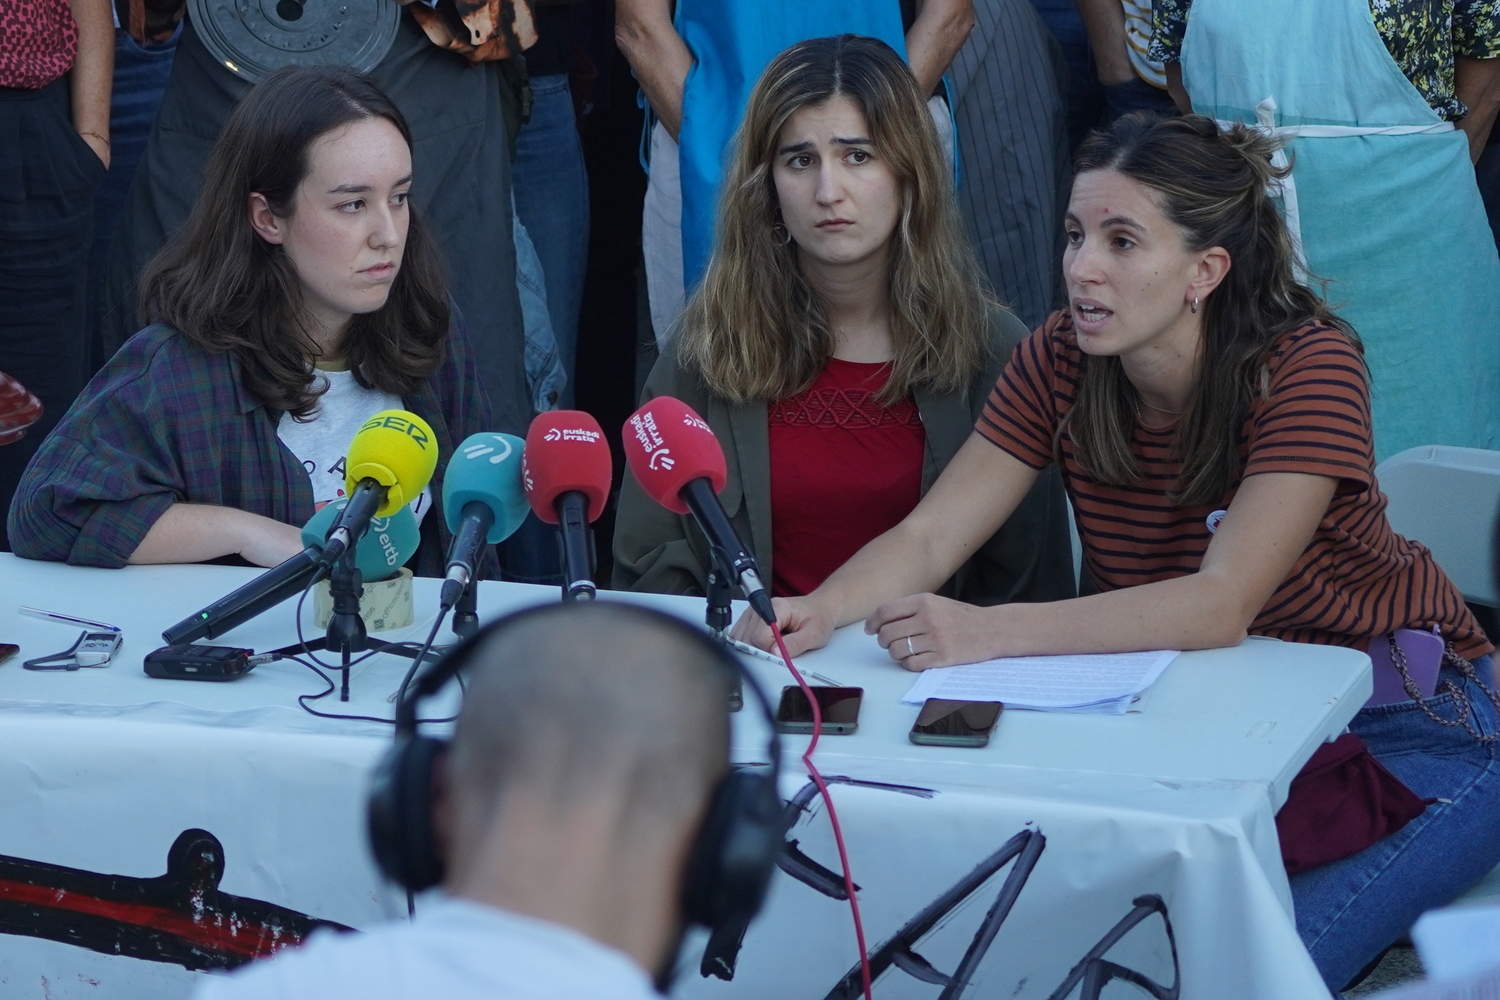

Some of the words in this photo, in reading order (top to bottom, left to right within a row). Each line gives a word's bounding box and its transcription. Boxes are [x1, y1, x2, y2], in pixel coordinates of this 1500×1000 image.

[358, 416, 429, 451] SER
[562, 428, 600, 439] euskadi
[630, 413, 653, 453] euskadi
[379, 533, 399, 566] eitb
